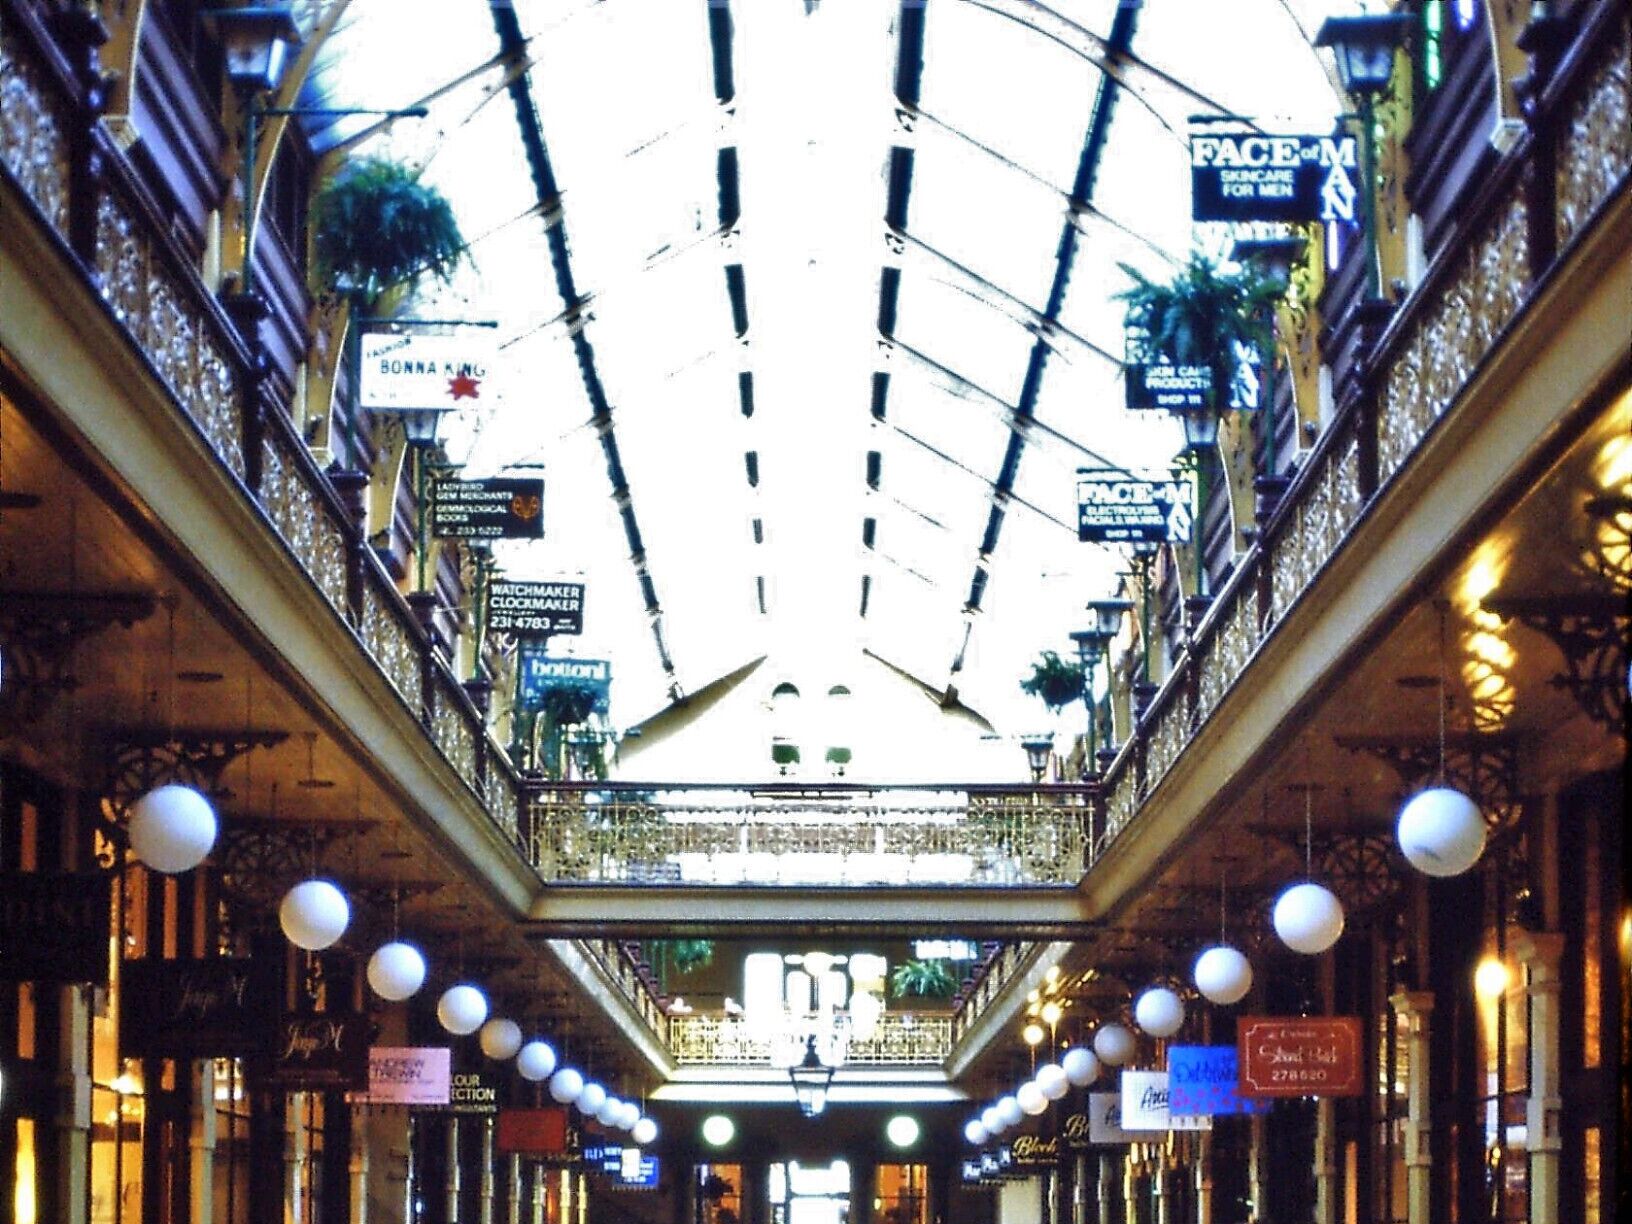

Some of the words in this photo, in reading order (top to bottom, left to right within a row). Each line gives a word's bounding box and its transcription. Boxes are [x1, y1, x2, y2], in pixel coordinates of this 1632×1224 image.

[1191, 137, 1300, 167] FACE
[1220, 169, 1294, 183] SKINCARE
[1222, 183, 1254, 197] FOR
[1258, 183, 1293, 197] MEN
[1078, 482, 1153, 505] FACE
[491, 584, 580, 598] WATCHMAKER
[490, 596, 580, 611] CLOCKMAKER
